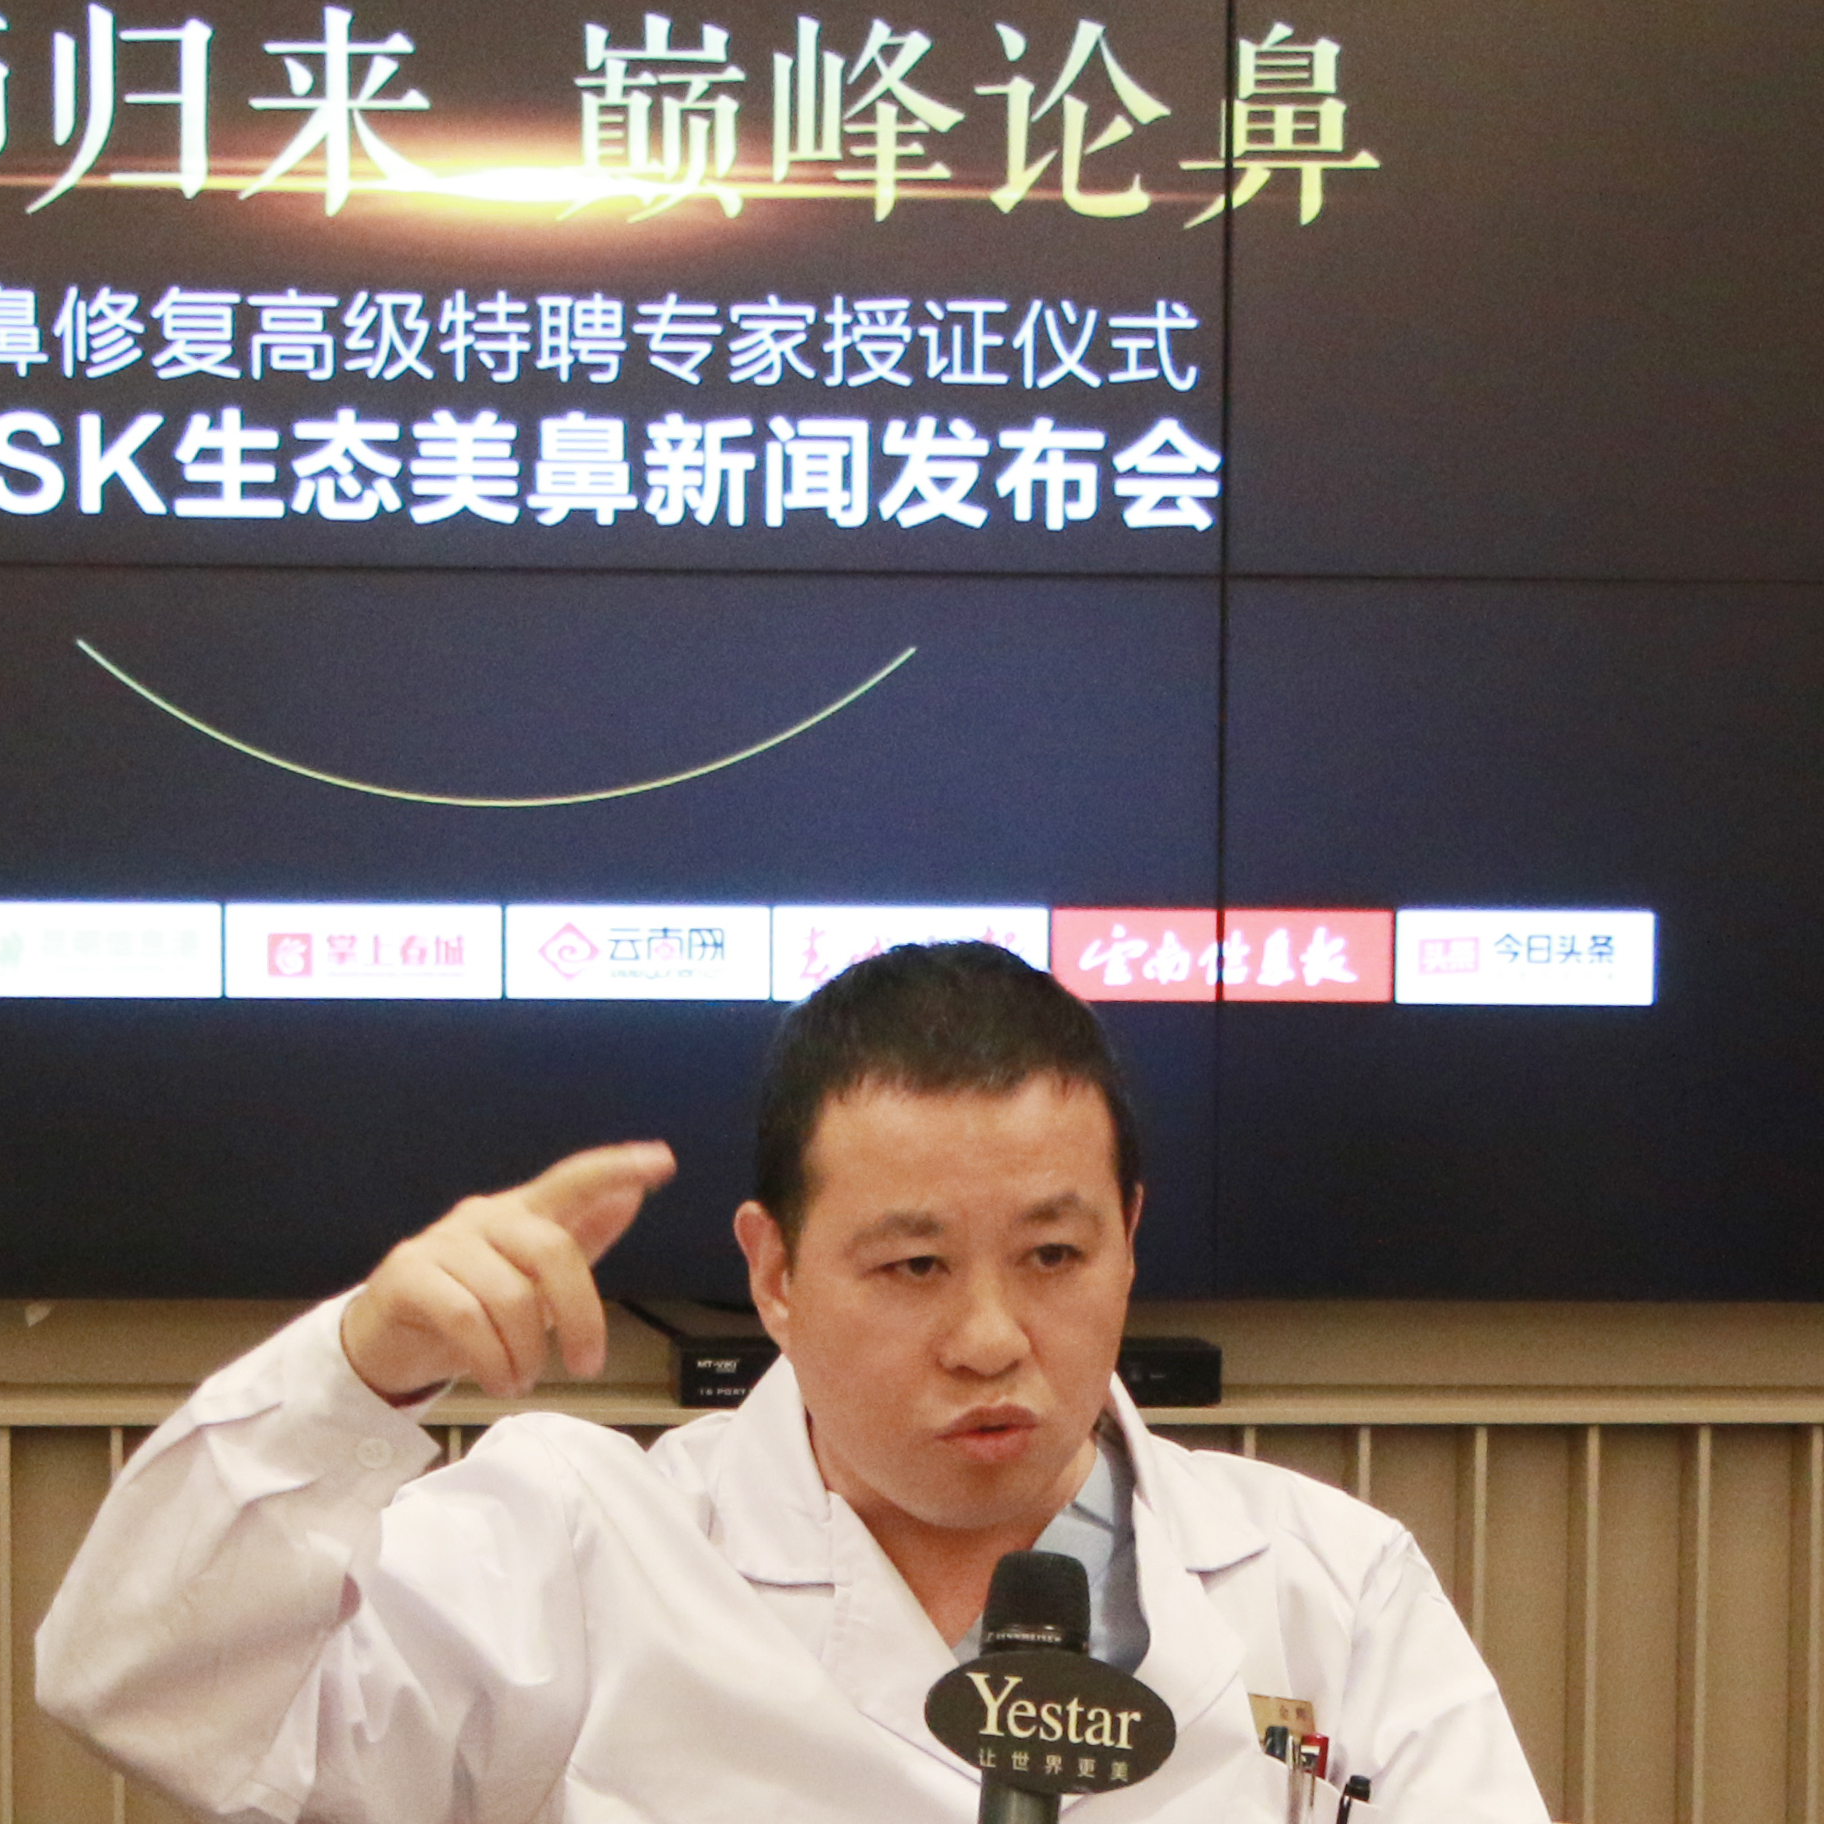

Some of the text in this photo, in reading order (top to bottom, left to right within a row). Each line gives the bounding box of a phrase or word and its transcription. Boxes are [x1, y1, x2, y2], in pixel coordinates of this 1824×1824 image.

[556, 13, 1380, 228] 巅峰论鼻
[609, 927, 725, 961] 云南网
[1494, 933, 1615, 965] 今日头条
[966, 1671, 1142, 1750] Yestar
[979, 1747, 1129, 1782] 让世界更美
